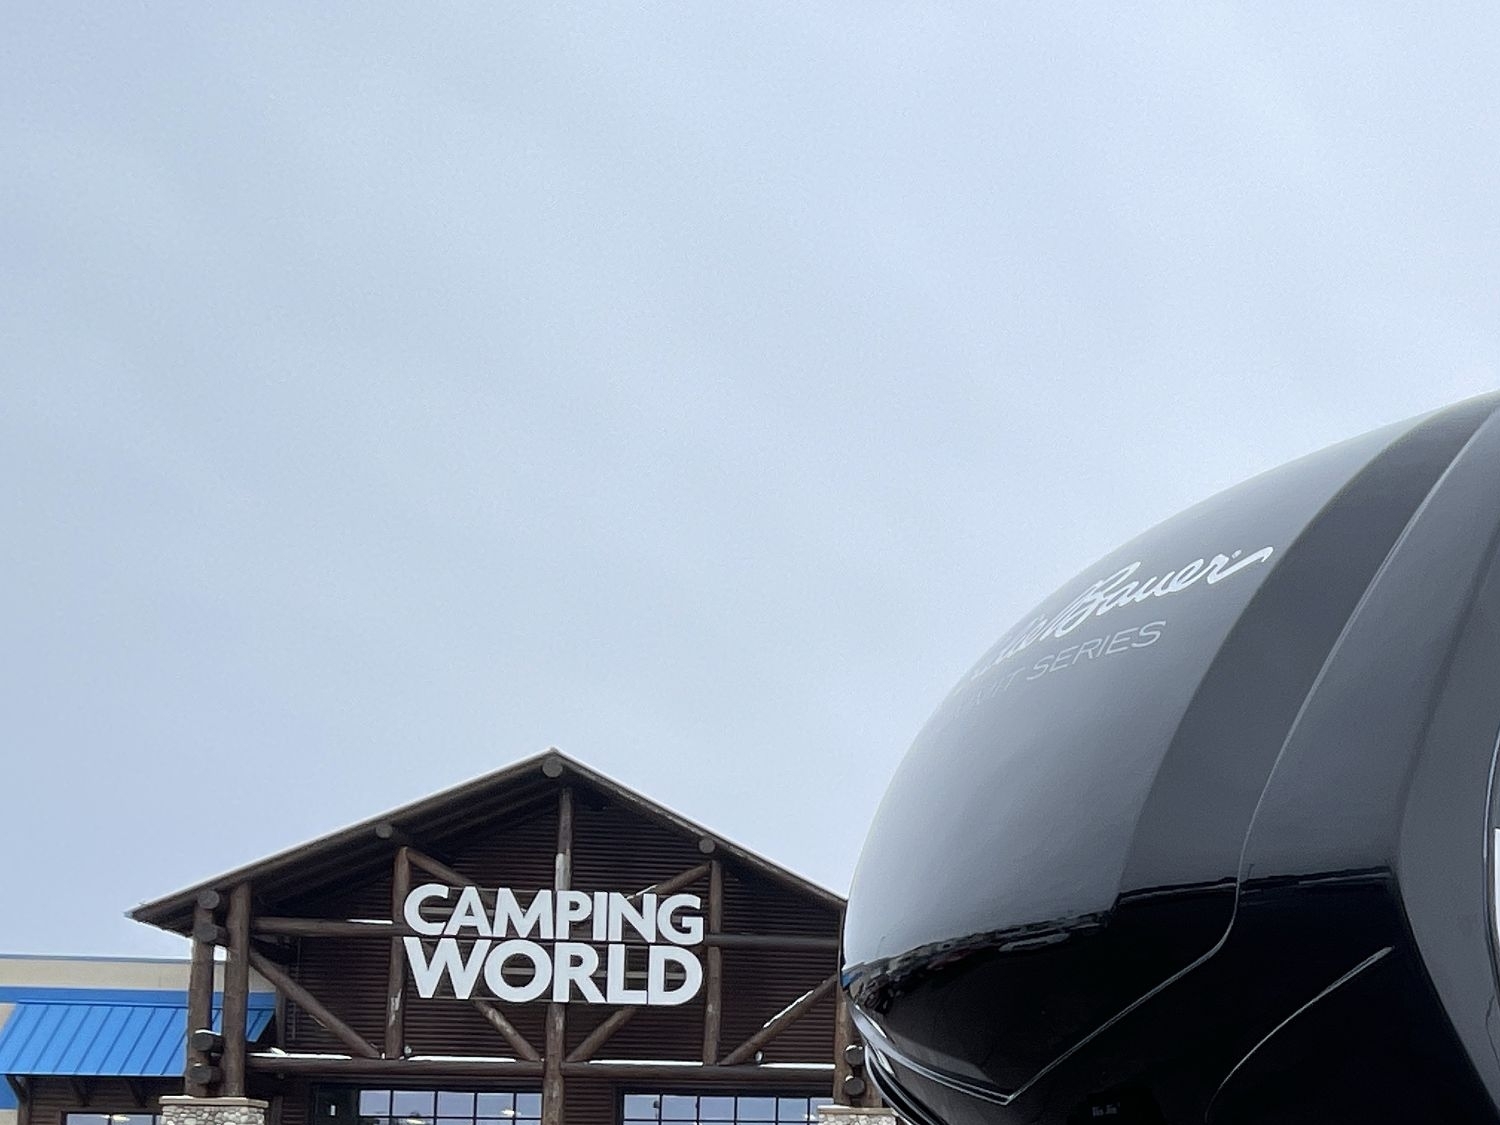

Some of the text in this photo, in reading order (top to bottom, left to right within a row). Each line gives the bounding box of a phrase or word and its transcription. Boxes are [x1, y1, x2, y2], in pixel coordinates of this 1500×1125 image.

[1026, 620, 1167, 681] SERIES
[403, 883, 704, 946] CAMPING
[403, 936, 703, 1006] WORLD
